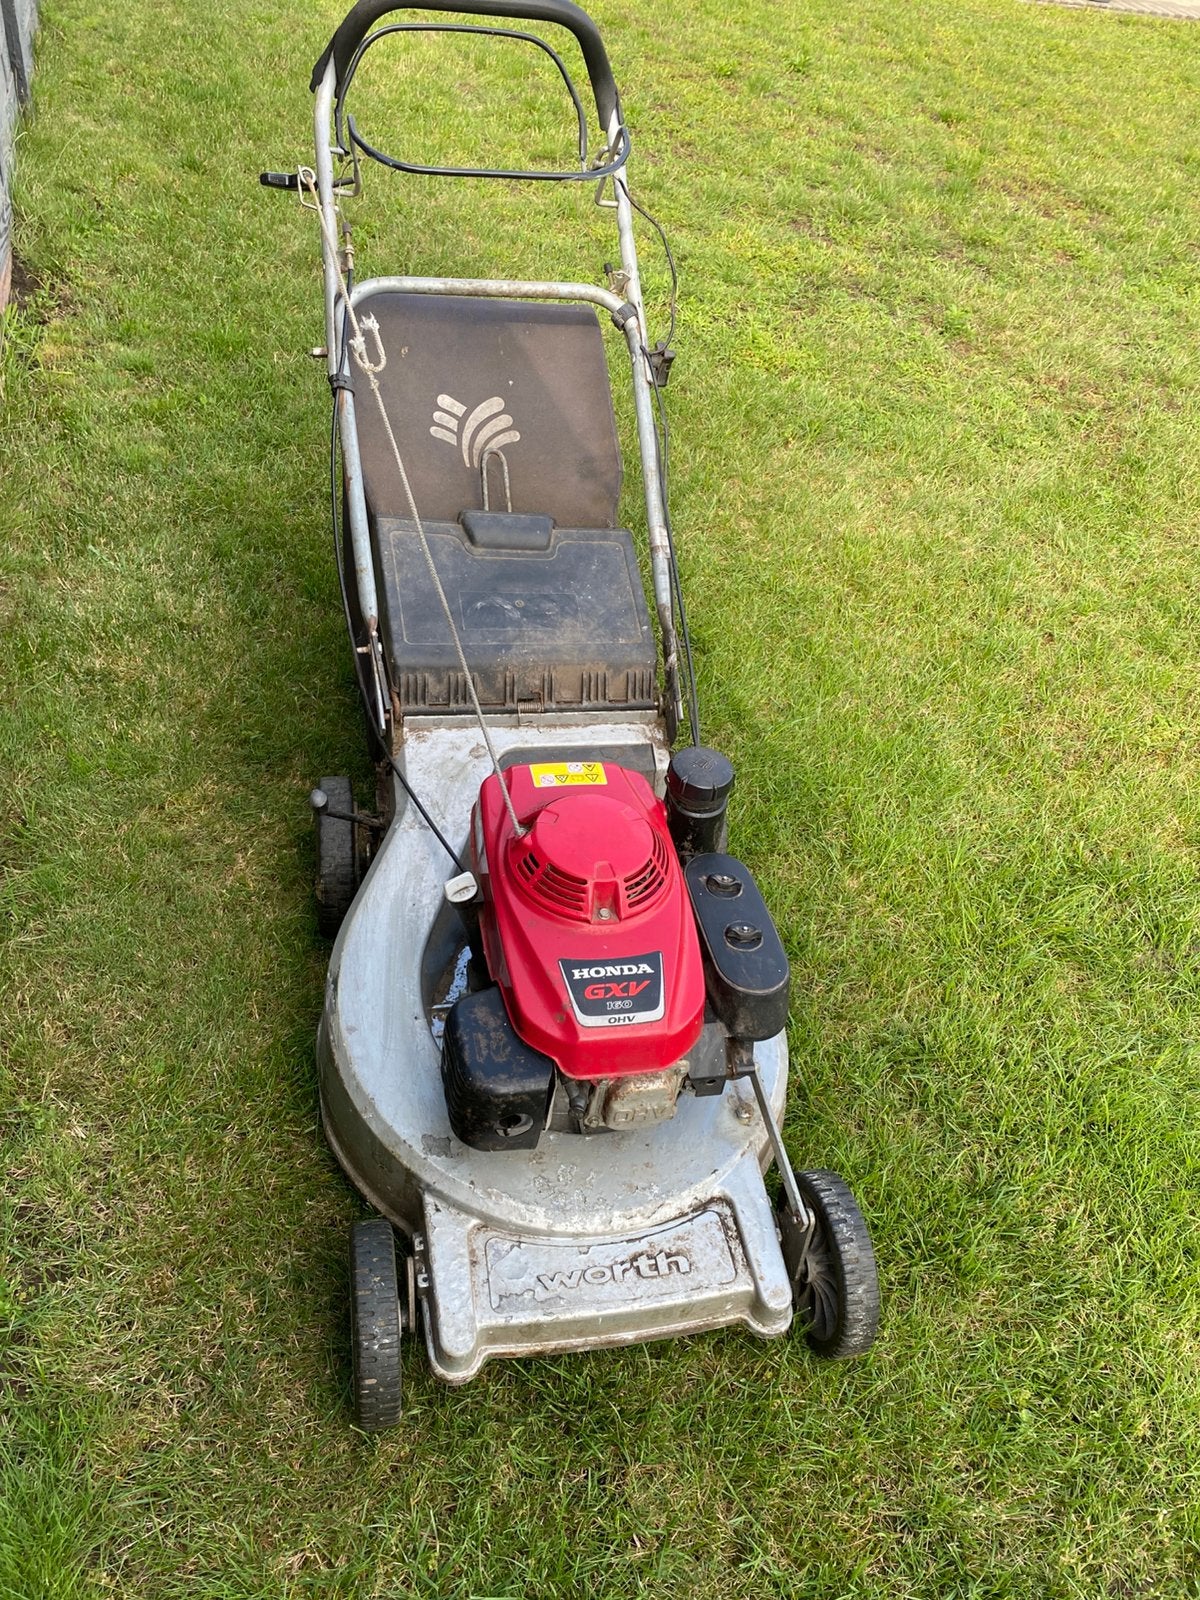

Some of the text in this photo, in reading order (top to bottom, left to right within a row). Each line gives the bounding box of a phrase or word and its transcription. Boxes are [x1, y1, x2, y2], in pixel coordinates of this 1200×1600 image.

[571, 963, 654, 979] HONDA
[584, 980, 651, 999] GXV
[606, 1000, 633, 1010] 160
[608, 1015, 636, 1024] OHV
[537, 1251, 691, 1289] worth
